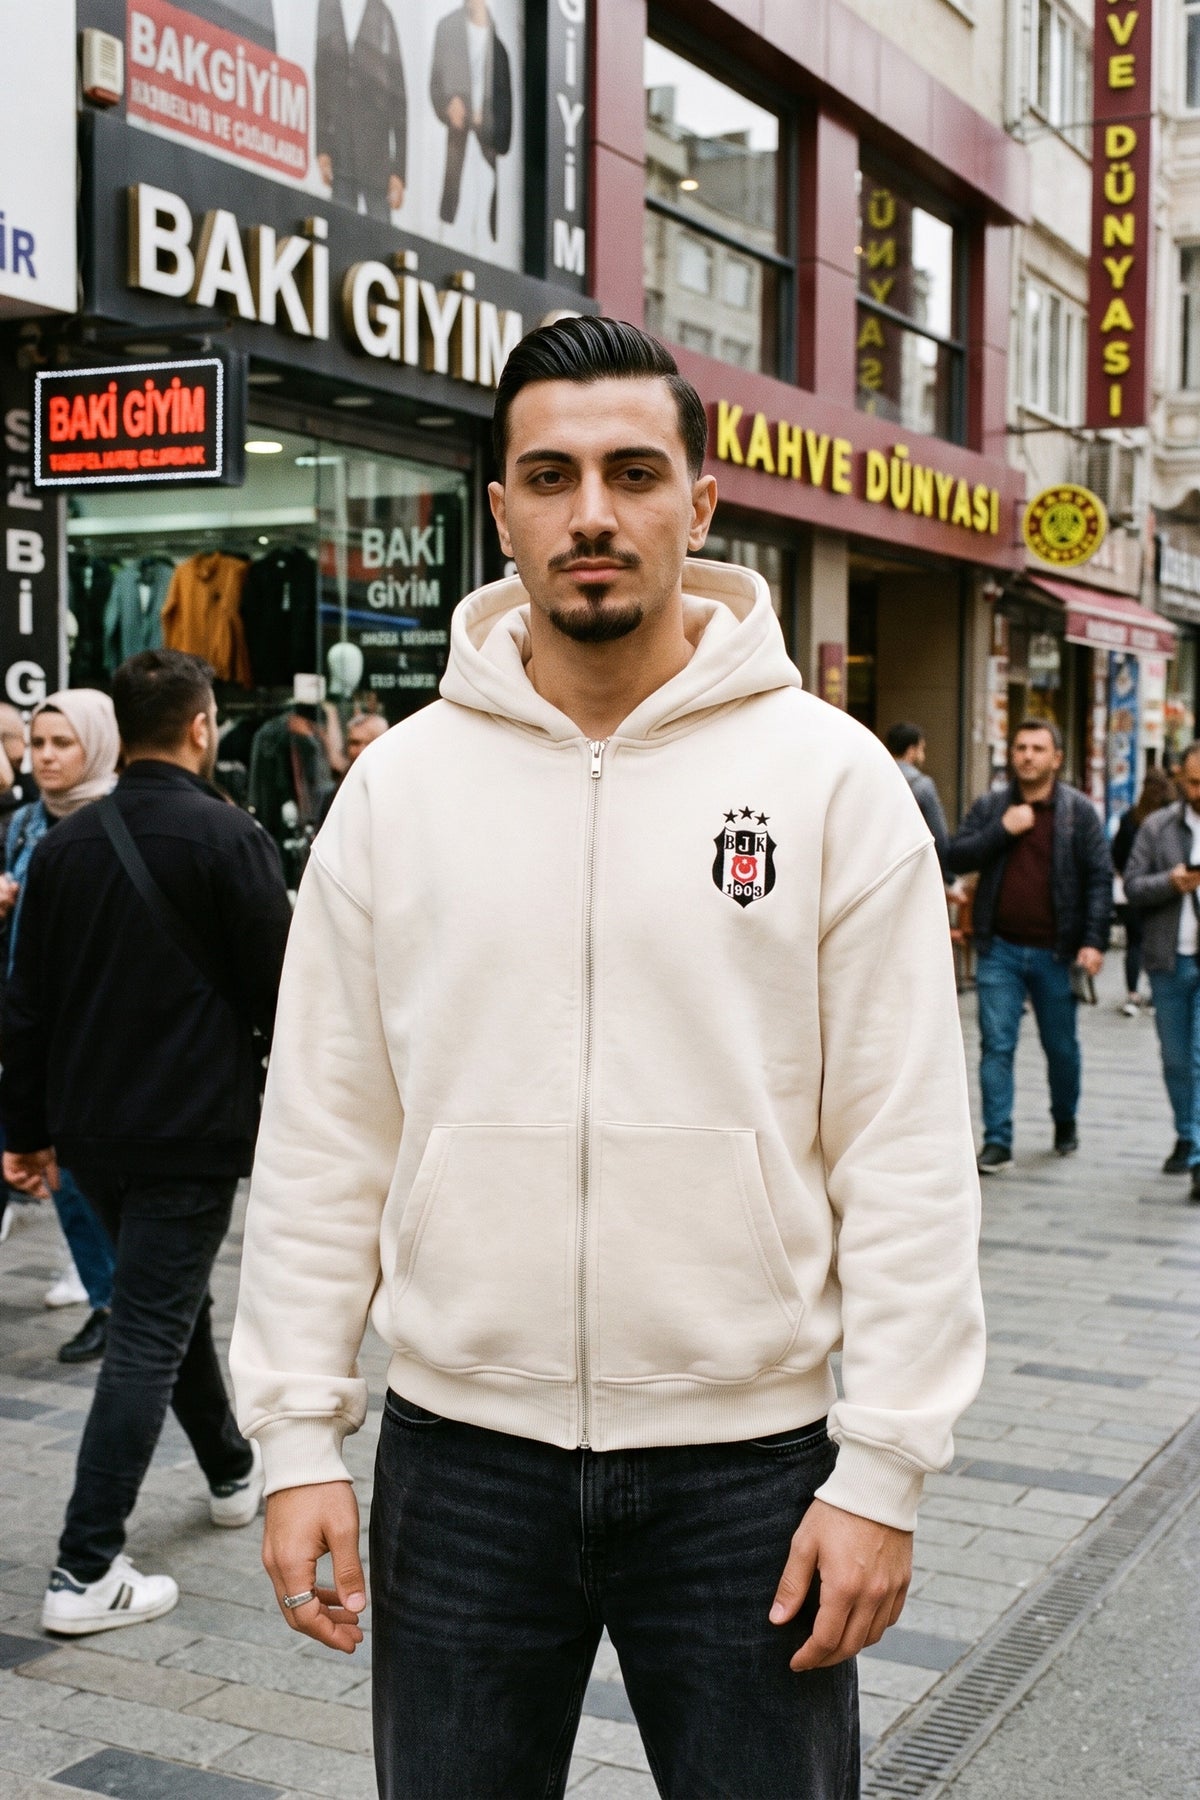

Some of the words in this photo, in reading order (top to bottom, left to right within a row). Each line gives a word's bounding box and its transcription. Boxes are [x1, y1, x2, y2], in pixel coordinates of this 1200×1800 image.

[130, 11, 307, 135] BAKGİYİM
[1106, 0, 1139, 88] VE
[132, 182, 330, 341] BAKİ
[346, 250, 524, 389] GİYİM
[1101, 125, 1138, 418] DÜNYASI
[49, 380, 117, 443] BAKİ
[123, 376, 206, 439] GİYİM
[716, 399, 853, 496] KAHVE
[866, 443, 1000, 536] DÜNYASI
[361, 514, 446, 569] BAKİ
[366, 573, 441, 609] GİYİM
[724, 834, 767, 853] BJK
[726, 883, 763, 898] 1903
